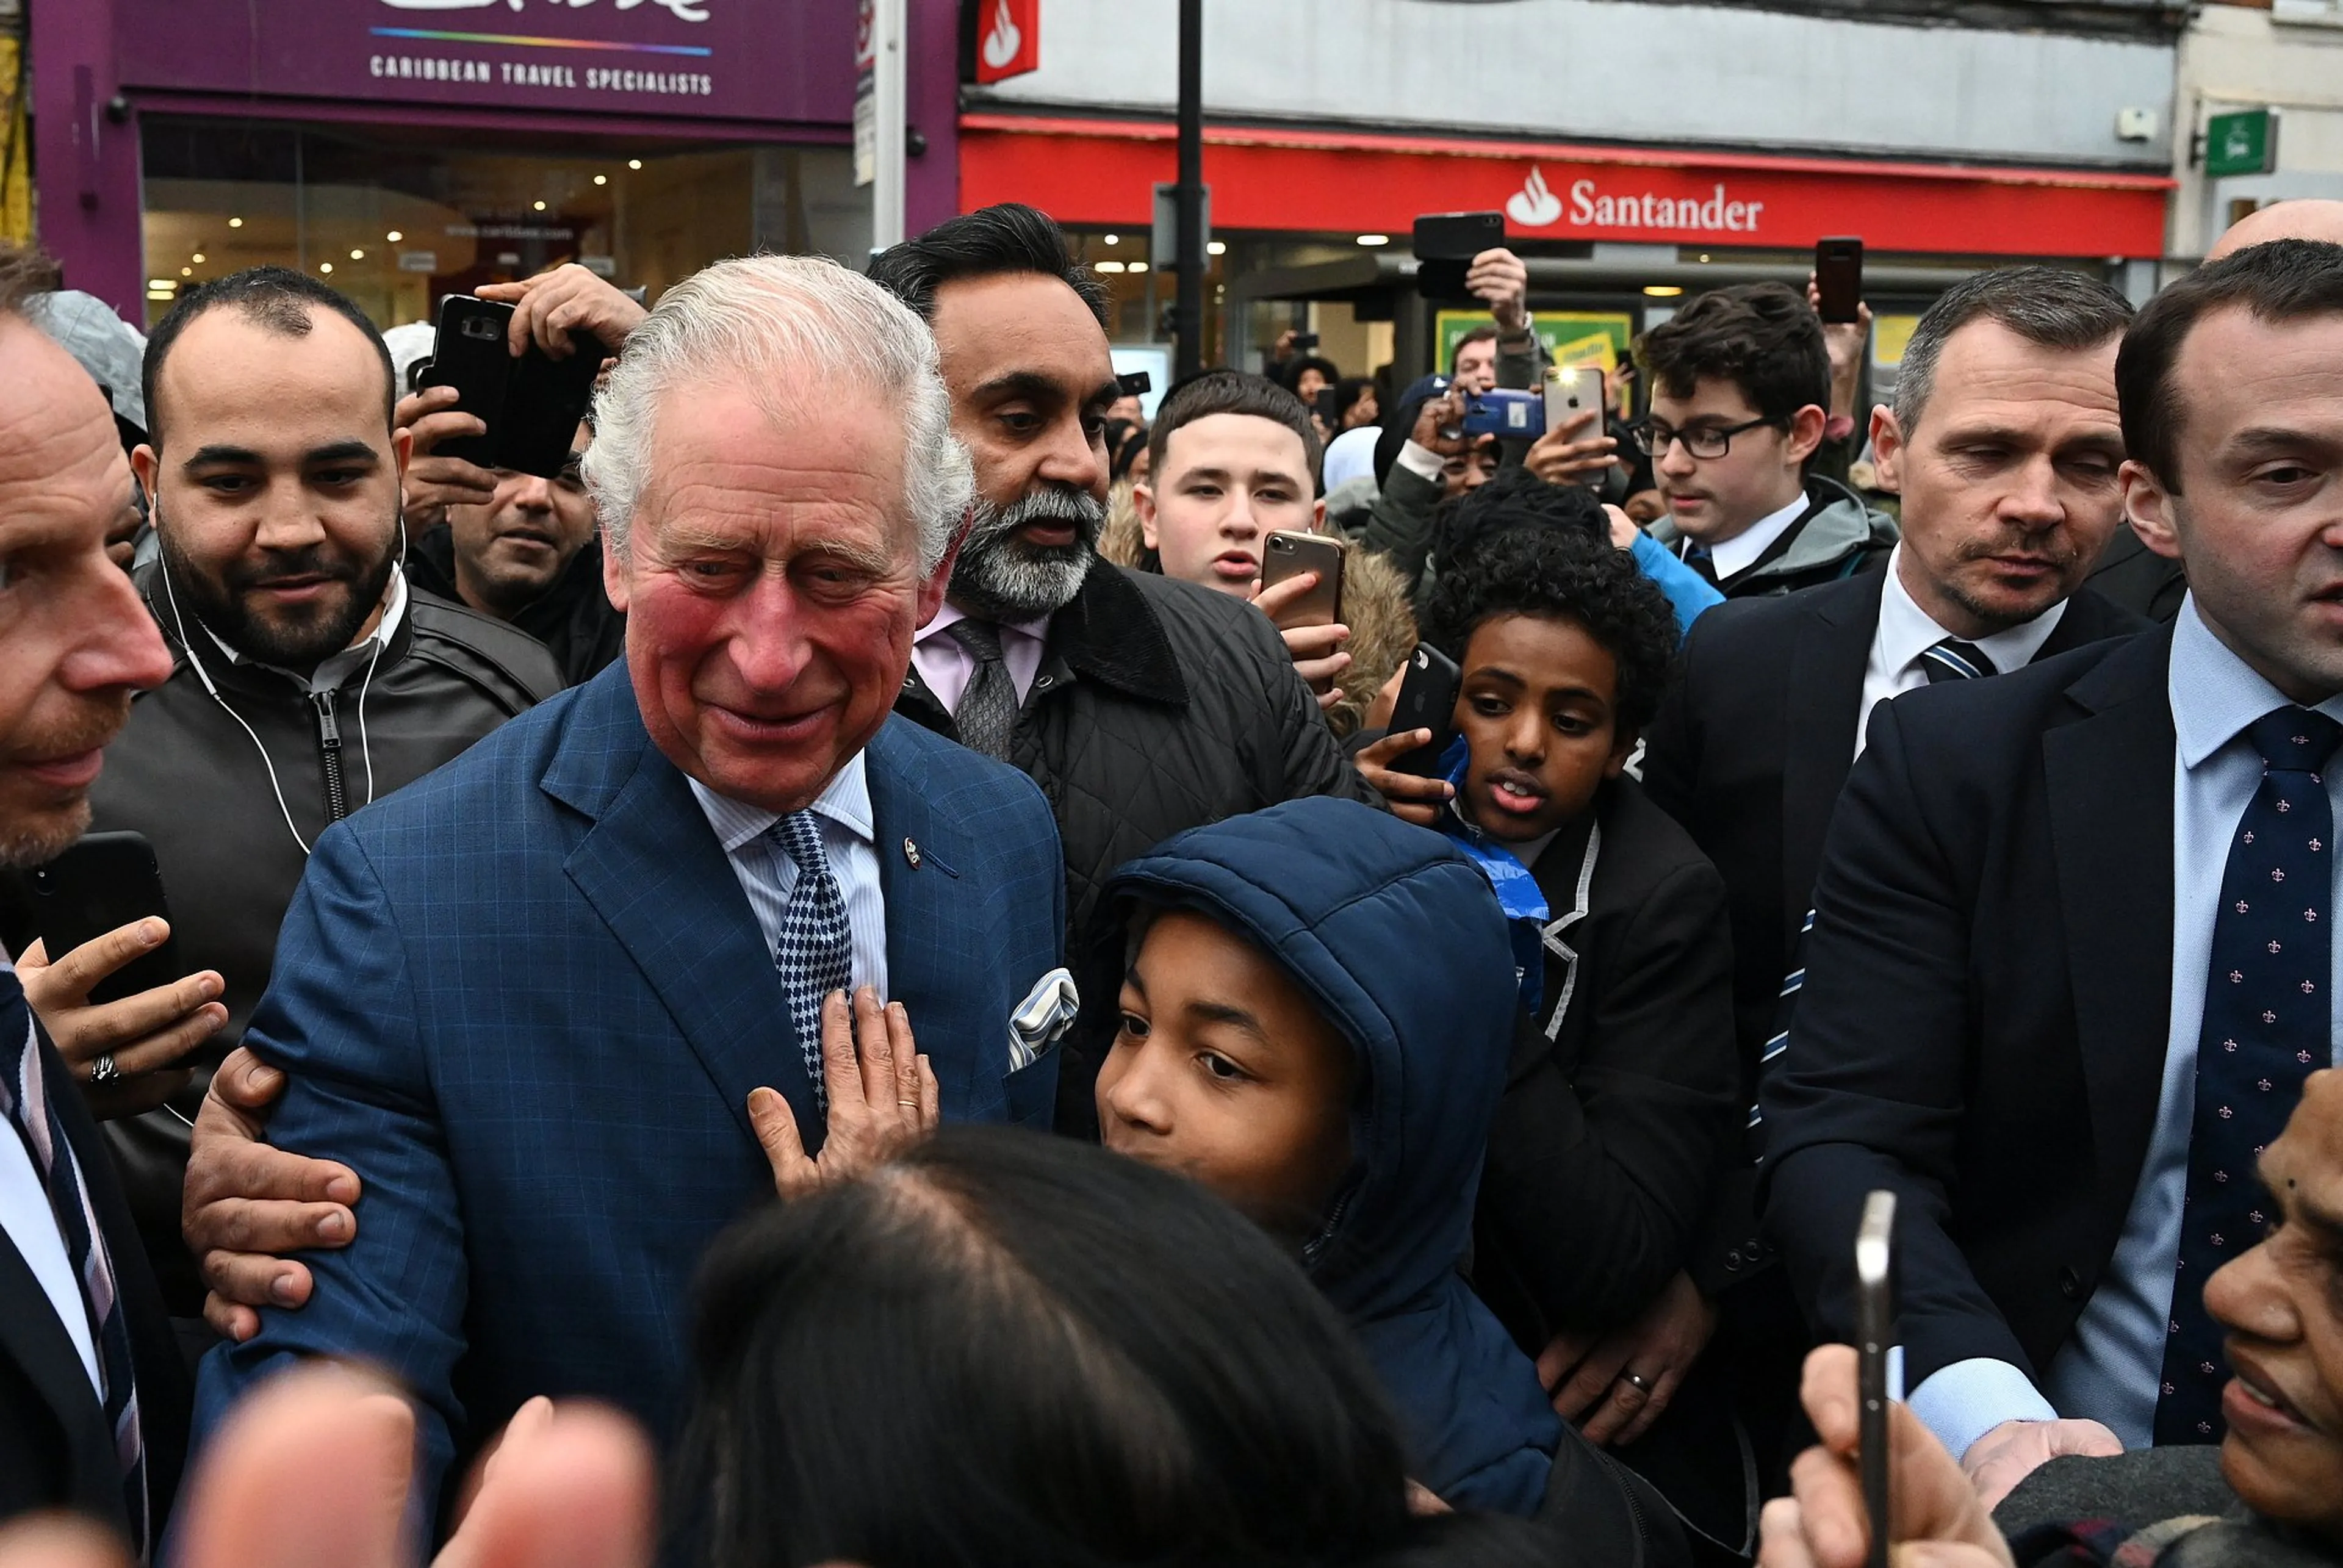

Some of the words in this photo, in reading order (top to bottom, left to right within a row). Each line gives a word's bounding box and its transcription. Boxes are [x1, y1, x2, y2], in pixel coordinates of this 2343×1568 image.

[370, 55, 490, 83] CARIBBEAN
[500, 62, 577, 88] TRAVEL
[586, 68, 711, 95] SPECIALISTS
[1569, 179, 1764, 231] Santander
